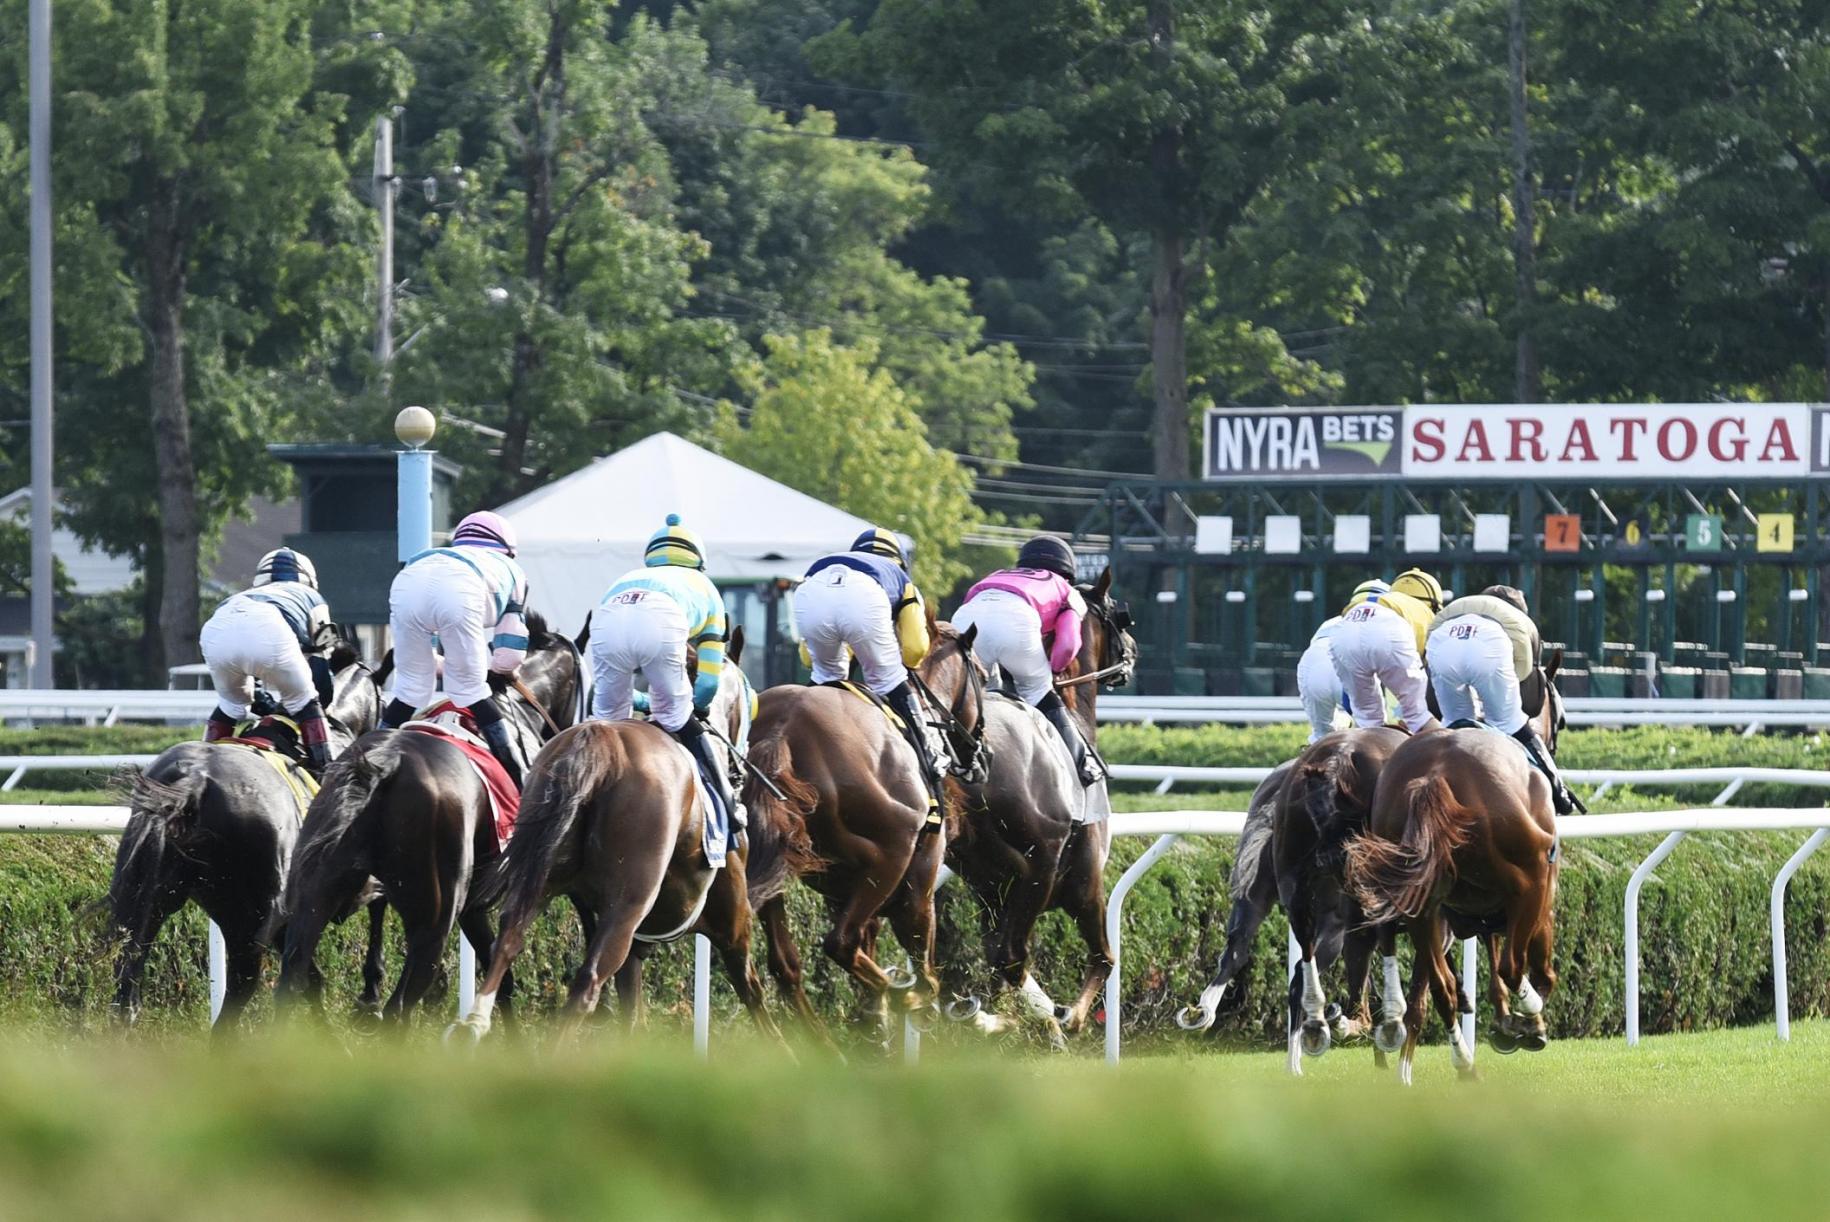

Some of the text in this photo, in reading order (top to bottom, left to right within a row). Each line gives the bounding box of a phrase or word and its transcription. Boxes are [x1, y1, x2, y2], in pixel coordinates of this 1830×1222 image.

[1218, 414, 1395, 471] NYRA BETS
[1412, 417, 1800, 462] SARATOGA
[1557, 521, 1569, 543] 7
[1625, 520, 1640, 545] 6
[1697, 519, 1712, 546] 5
[1768, 521, 1780, 543] 4
